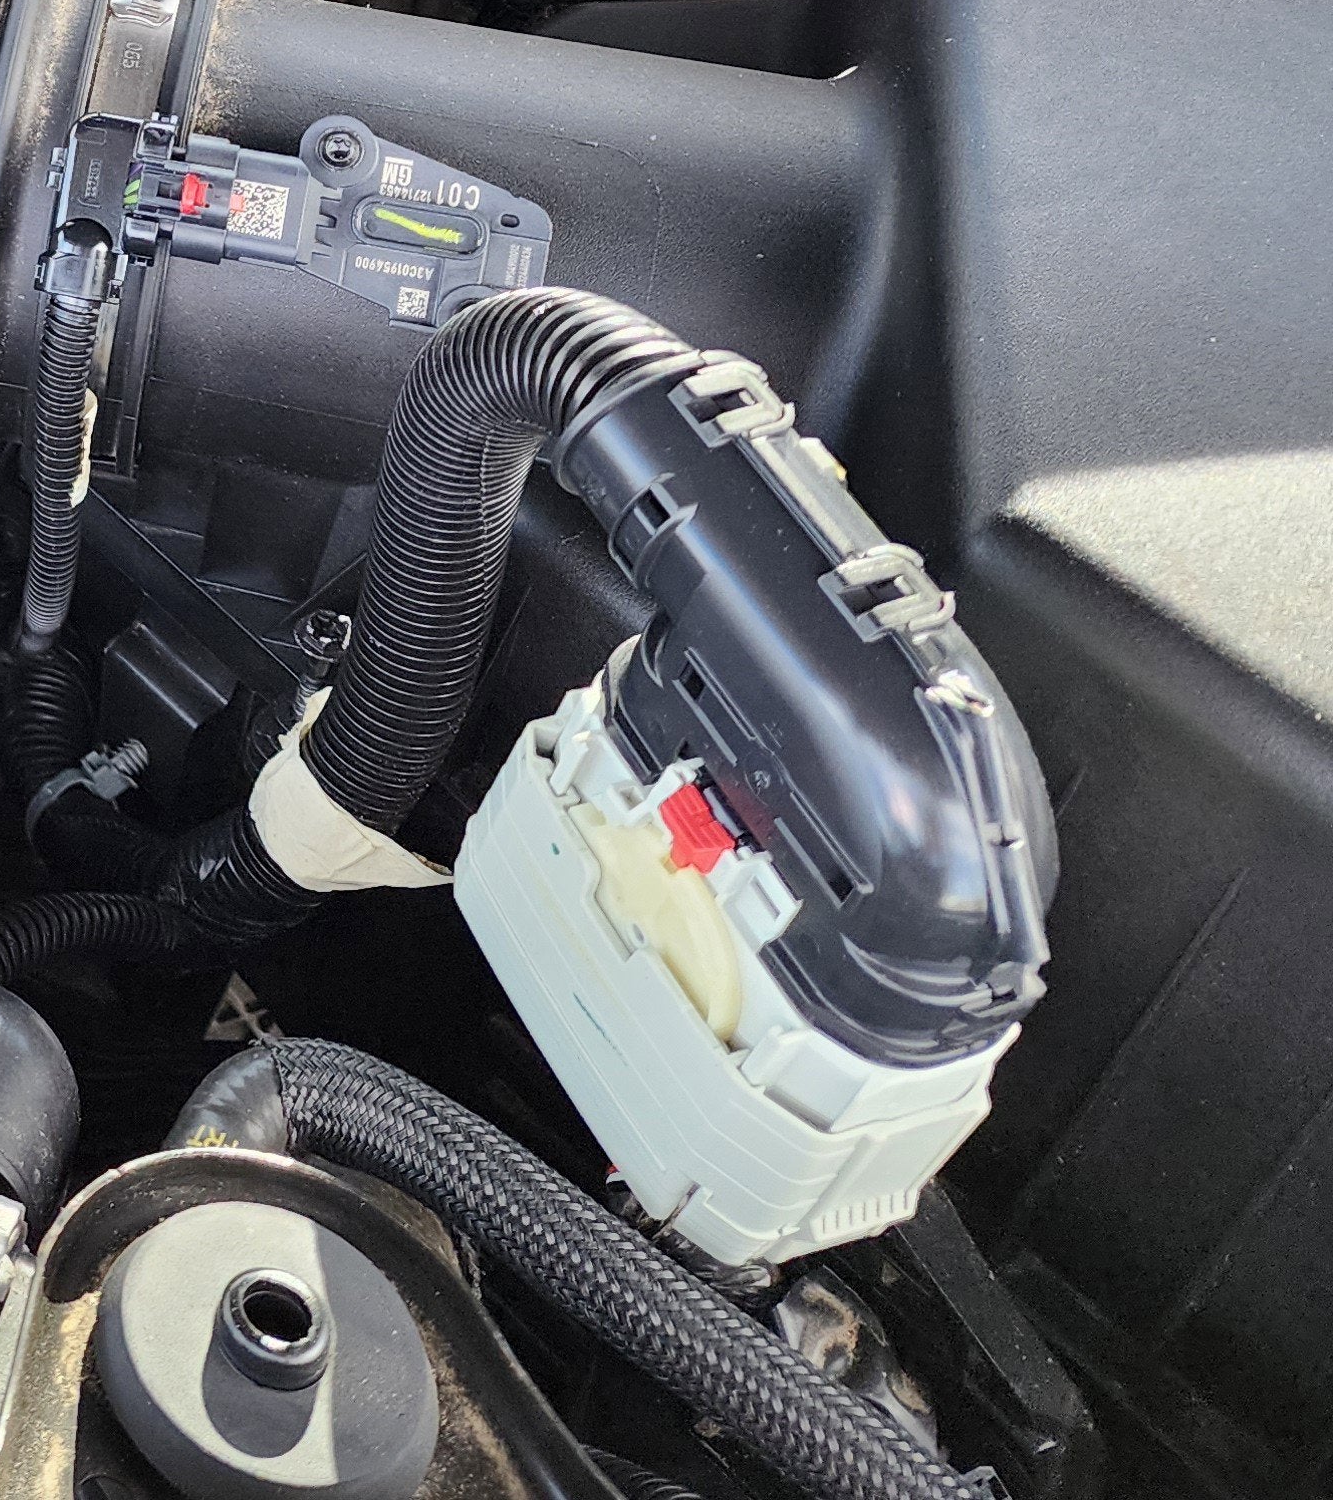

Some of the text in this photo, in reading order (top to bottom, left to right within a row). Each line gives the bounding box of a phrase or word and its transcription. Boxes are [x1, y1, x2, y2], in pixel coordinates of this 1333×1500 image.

[381, 159, 413, 187] GM
[436, 180, 480, 209] C01
[354, 255, 433, 280] A3C01954900
